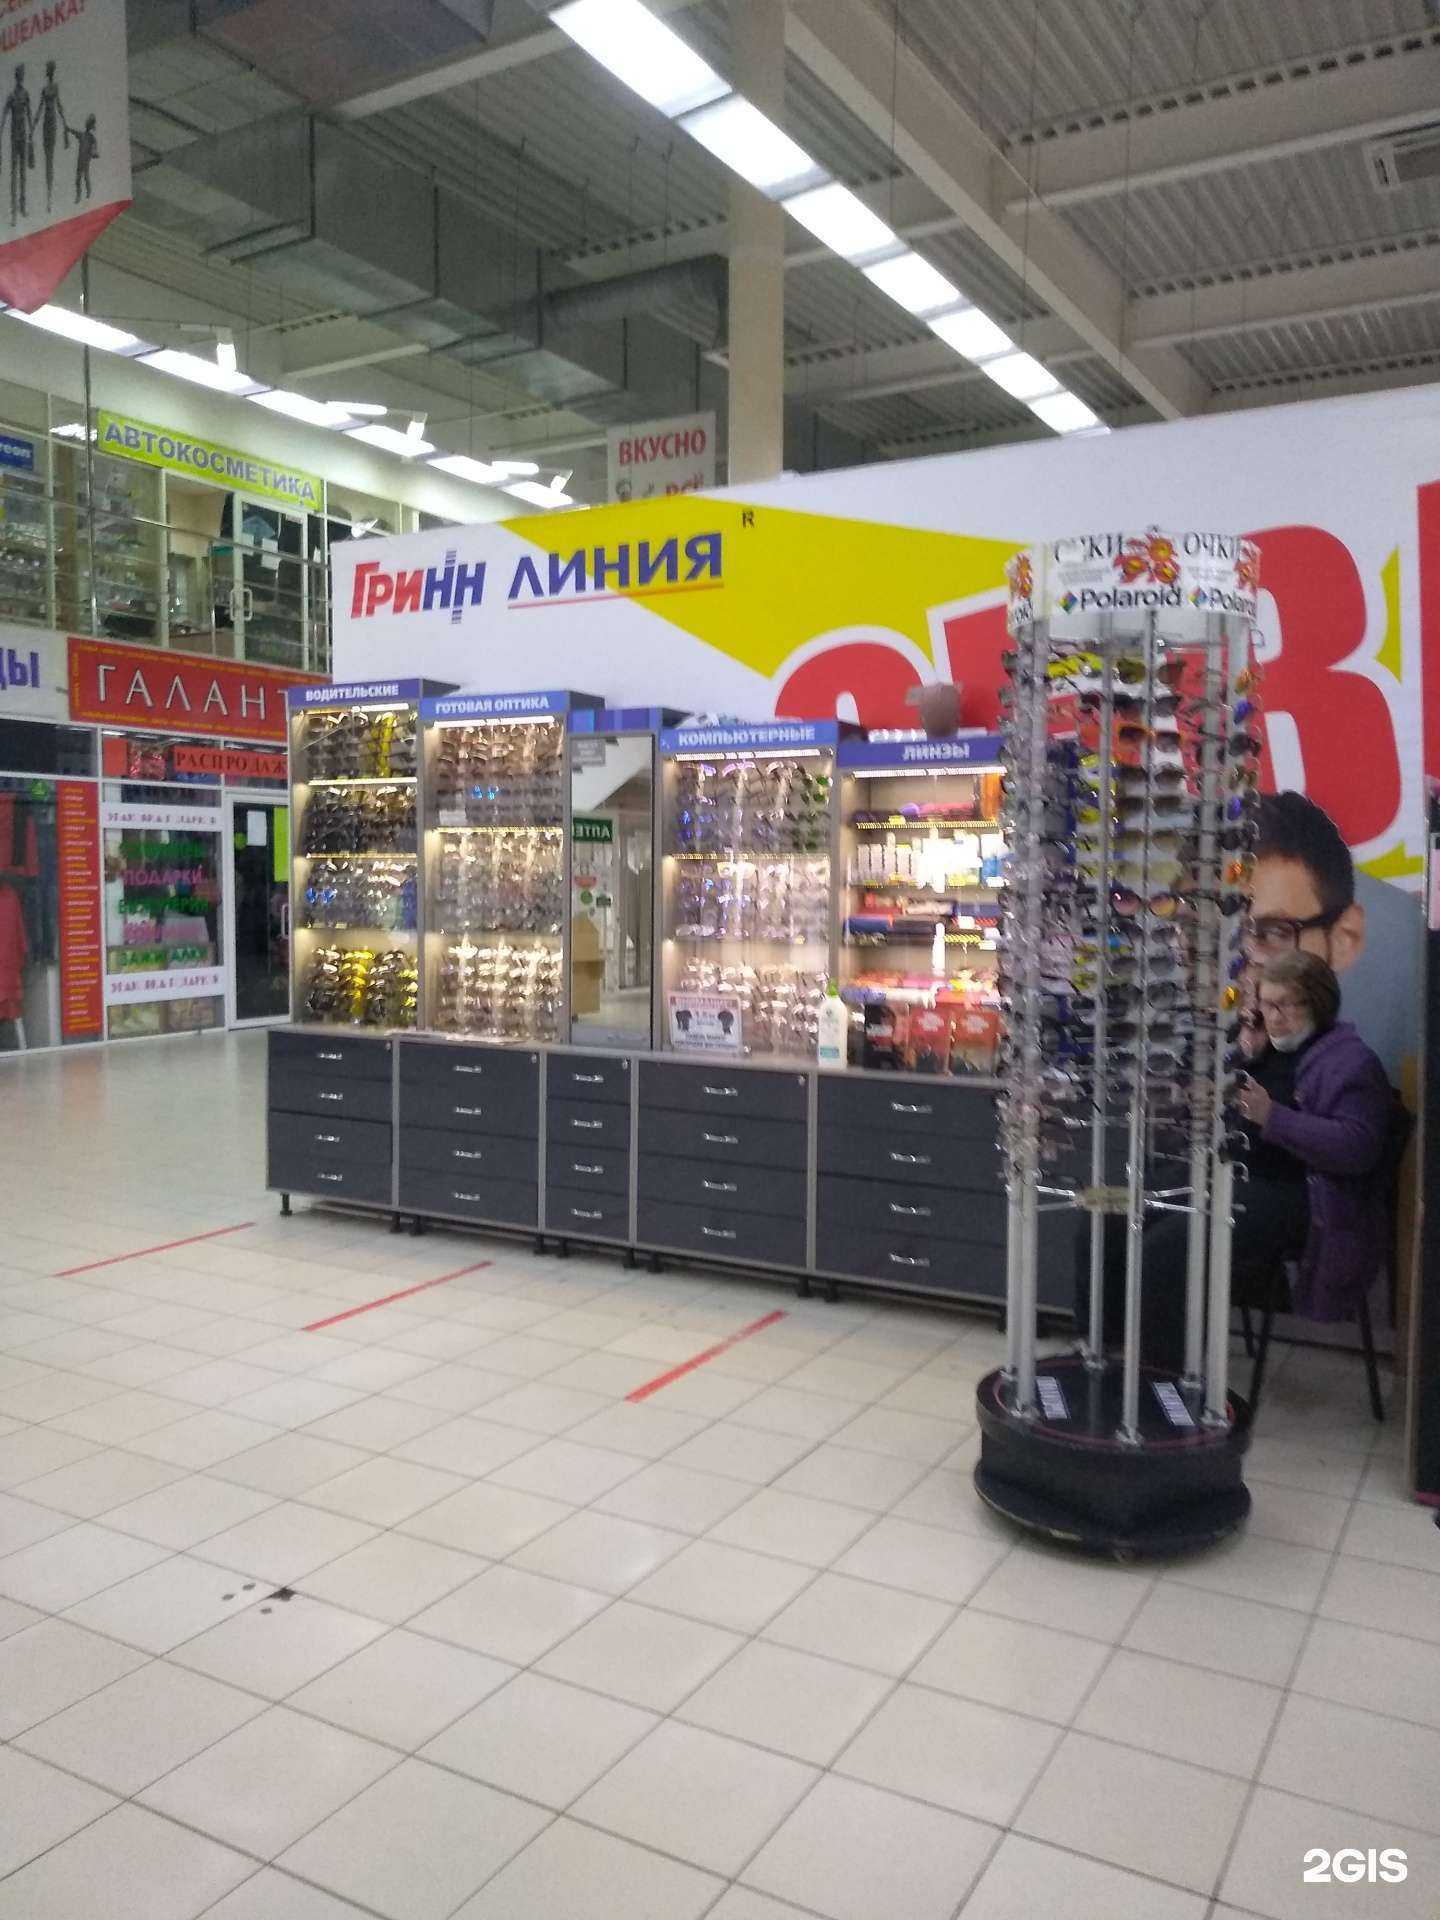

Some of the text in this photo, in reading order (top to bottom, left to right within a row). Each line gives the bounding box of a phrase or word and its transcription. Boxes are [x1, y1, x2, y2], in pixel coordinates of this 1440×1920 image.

[618, 429, 707, 466] ВКУСНО
[104, 422, 317, 501] АВТОКОСМЕТИКА
[507, 532, 723, 600] ЛИНИЯ
[1080, 585, 1181, 611] Polaroid
[305, 685, 399, 702] ВОДИТЕЛЬСКИЕ
[435, 695, 549, 714] ГОТОВАЯ ОПТИКА
[678, 728, 815, 747] КОМПЬЮТЕРНЫЕ
[903, 744, 970, 762] ЛИНЗЫ
